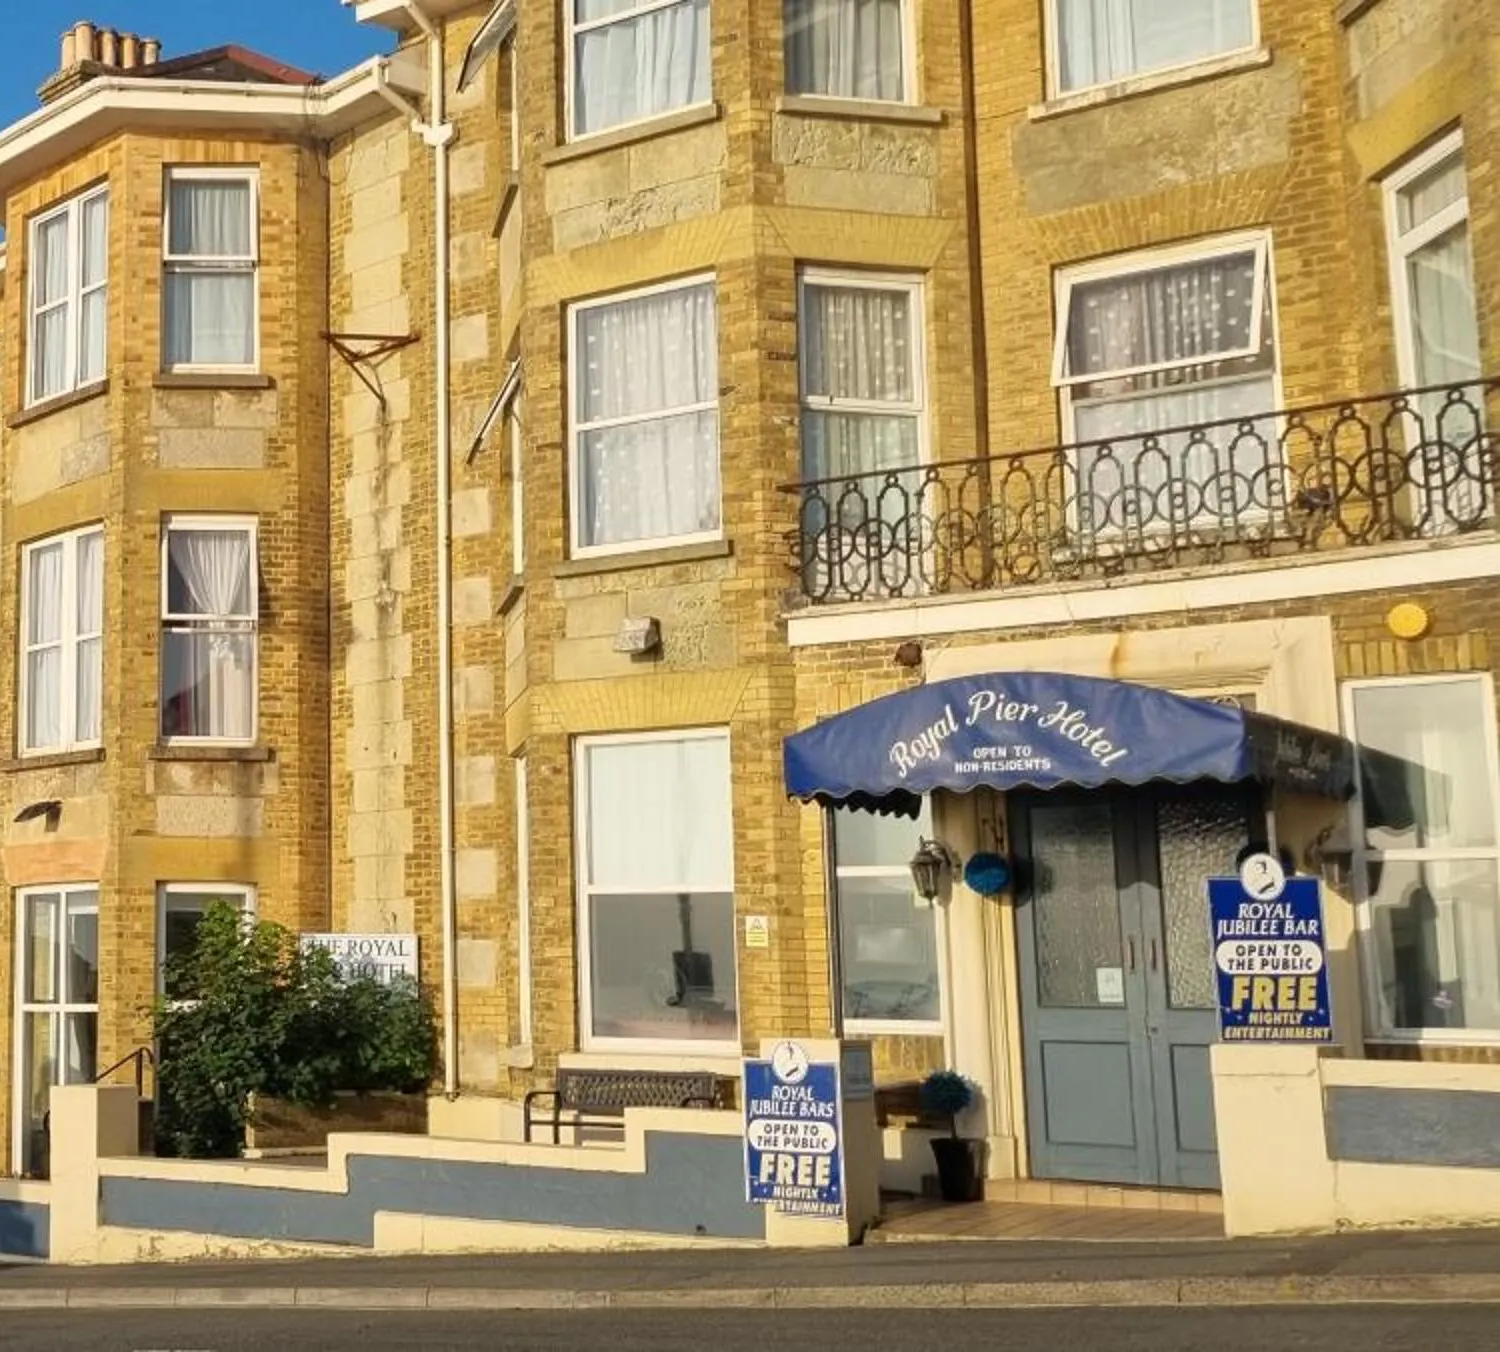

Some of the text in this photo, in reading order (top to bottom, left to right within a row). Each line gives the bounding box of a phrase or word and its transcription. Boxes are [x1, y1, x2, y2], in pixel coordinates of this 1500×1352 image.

[889, 690, 1129, 779] Royal Pier Hotel
[973, 745, 1032, 760] OPEN TO
[954, 757, 1052, 774] NON-RESIDENTS
[1238, 903, 1294, 920] ROYAL
[1217, 919, 1319, 939] JUBILEE BAR
[348, 940, 409, 957] ROYAL
[1235, 944, 1302, 957] OPEN TO
[1227, 958, 1313, 971] THE PUBLIC
[1231, 976, 1318, 1011] FREE
[1249, 1012, 1304, 1025] NIGHTLY
[1224, 1027, 1331, 1040] ENTERTAINMENT
[771, 1085, 814, 1101] ROYAL
[750, 1100, 834, 1118] JUBILEE BARS
[763, 1123, 819, 1136] OPEN TO
[757, 1136, 828, 1149] THE PUBLIC
[759, 1153, 832, 1187] FREE
[773, 1186, 819, 1199] NIGHTLY
